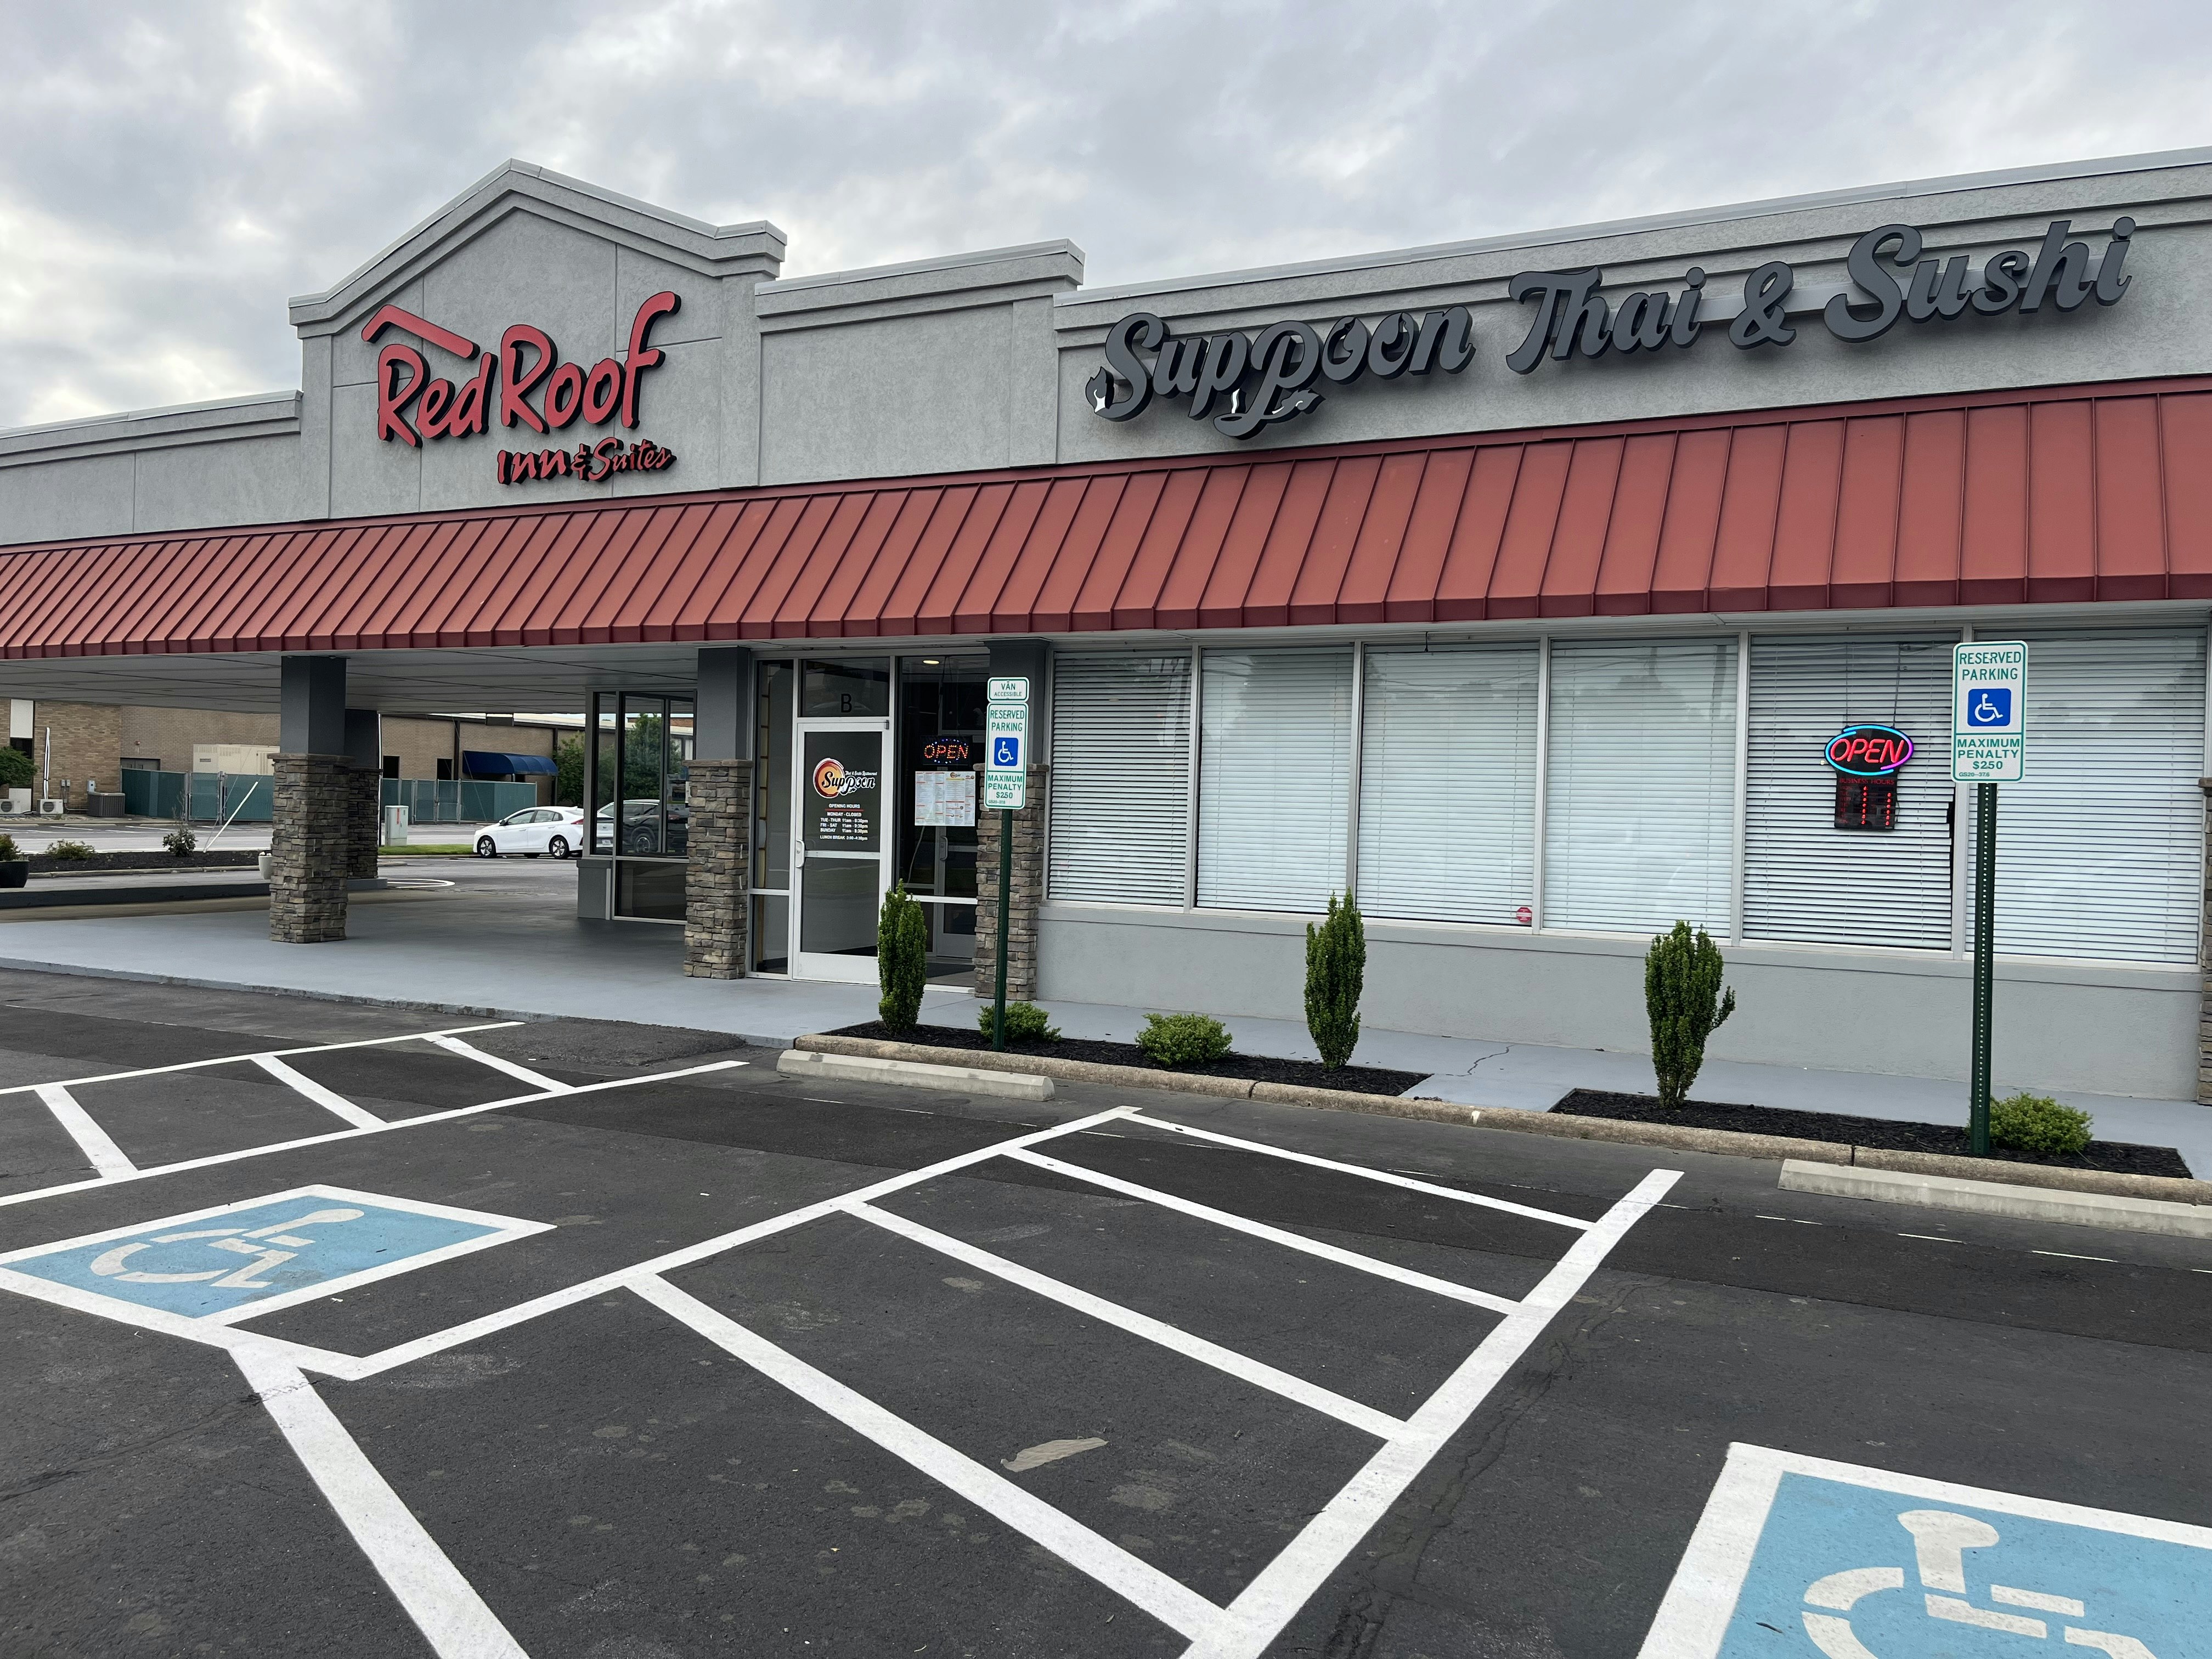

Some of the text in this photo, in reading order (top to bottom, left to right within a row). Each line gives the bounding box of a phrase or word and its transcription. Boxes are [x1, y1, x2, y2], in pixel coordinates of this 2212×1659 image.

[1505, 265, 1707, 375] Thai
[1728, 261, 1796, 350] &
[1824, 216, 2136, 343] Sushi
[377, 291, 681, 448] Red Roof
[497, 449, 573, 484] Inn
[588, 437, 677, 482] Suites
[1959, 651, 2021, 665] RESERVED
[1962, 668, 2018, 680] PARKING
[840, 693, 853, 713] B
[990, 710, 1025, 719] RESERVED
[991, 722, 1023, 731] PARKING
[1957, 738, 2020, 747] MAXIMUM
[924, 744, 969, 759] OPEN
[1830, 738, 1905, 763] OPEN
[1958, 749, 2019, 758] PENALTY
[1973, 761, 2003, 770] $250
